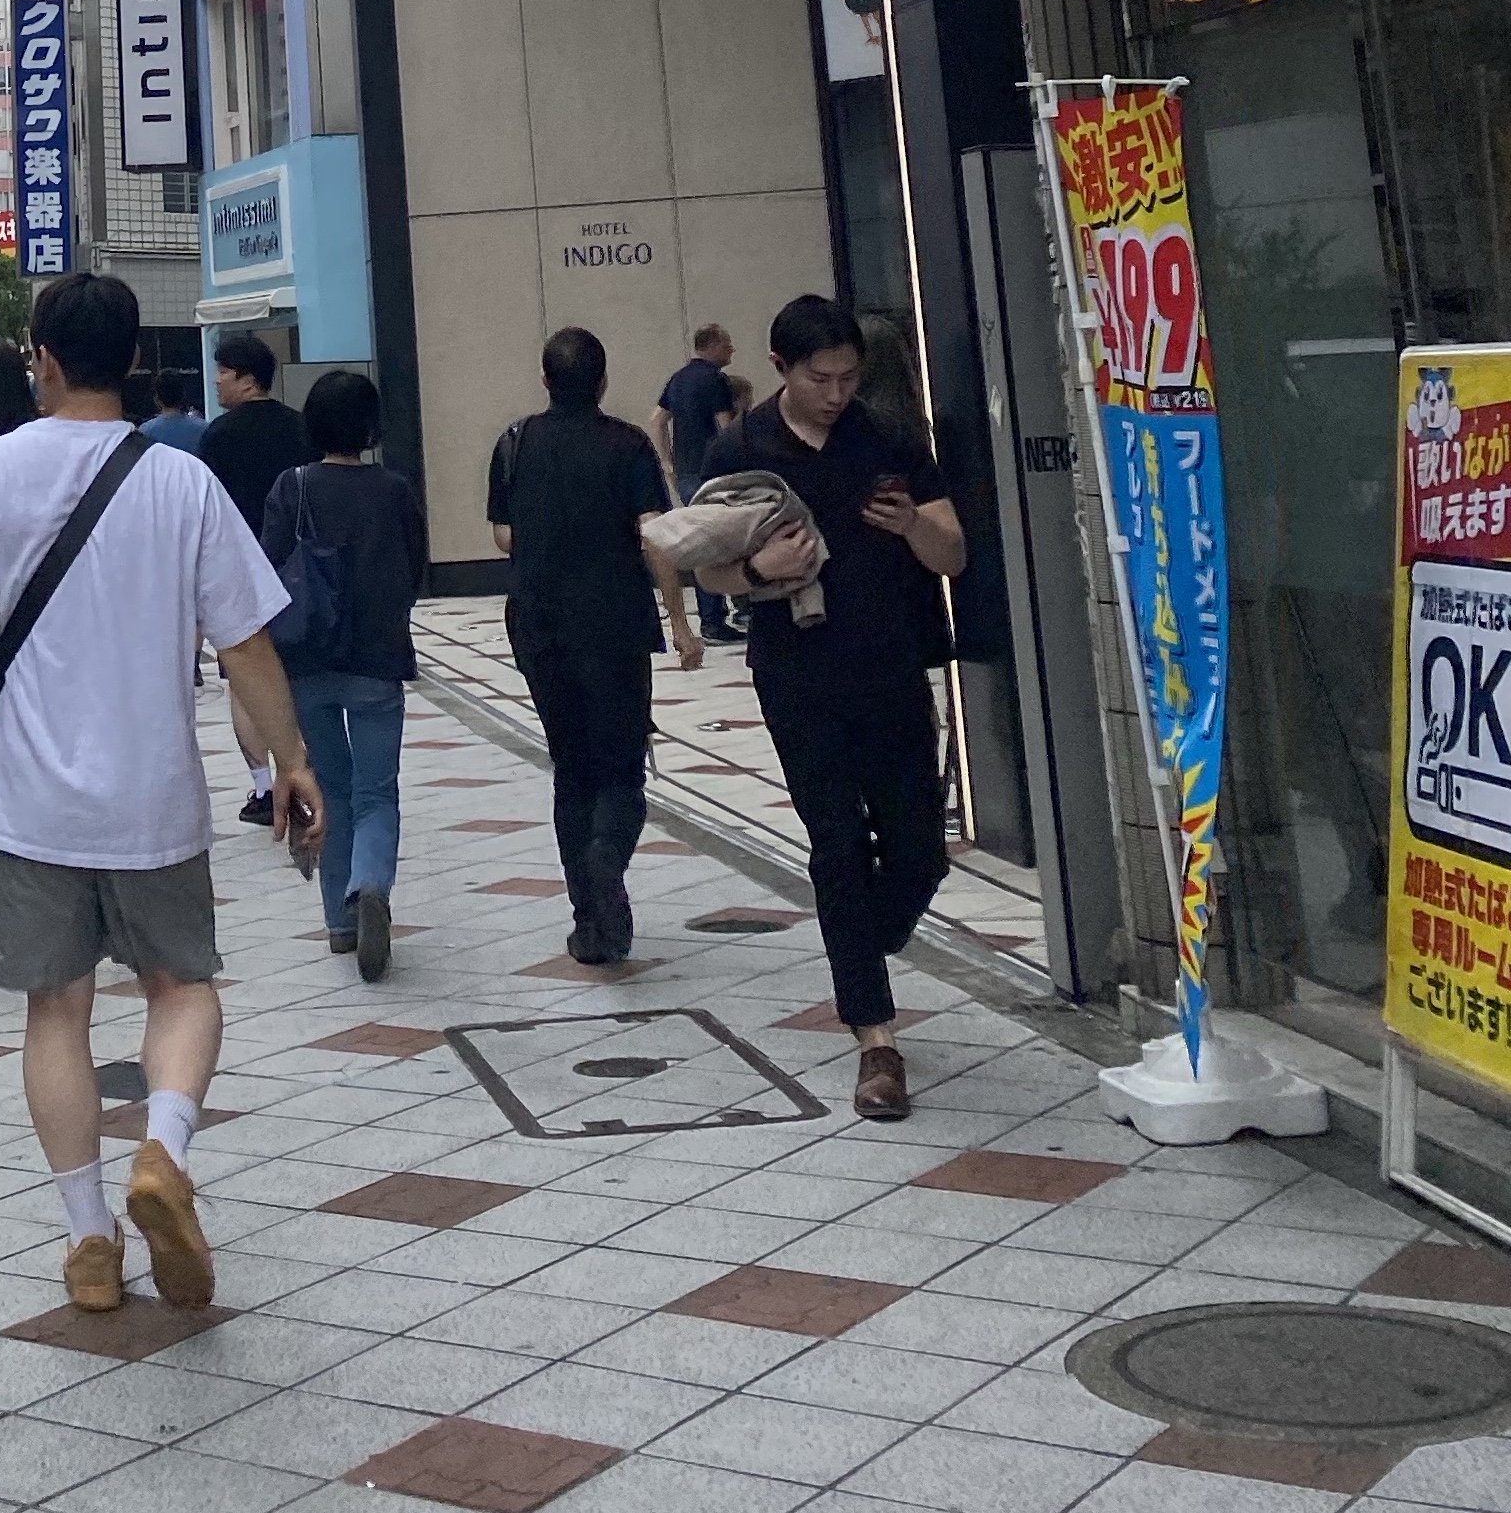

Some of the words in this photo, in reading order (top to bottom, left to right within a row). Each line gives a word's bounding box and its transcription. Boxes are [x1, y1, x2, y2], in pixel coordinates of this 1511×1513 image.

[20, 1, 64, 274] クロサワ楽器店
[563, 242, 652, 268] INDIGO
[580, 221, 633, 237] HOTEL
[1421, 635, 1511, 766] OK
[1403, 851, 1511, 931] 加熱式たば
